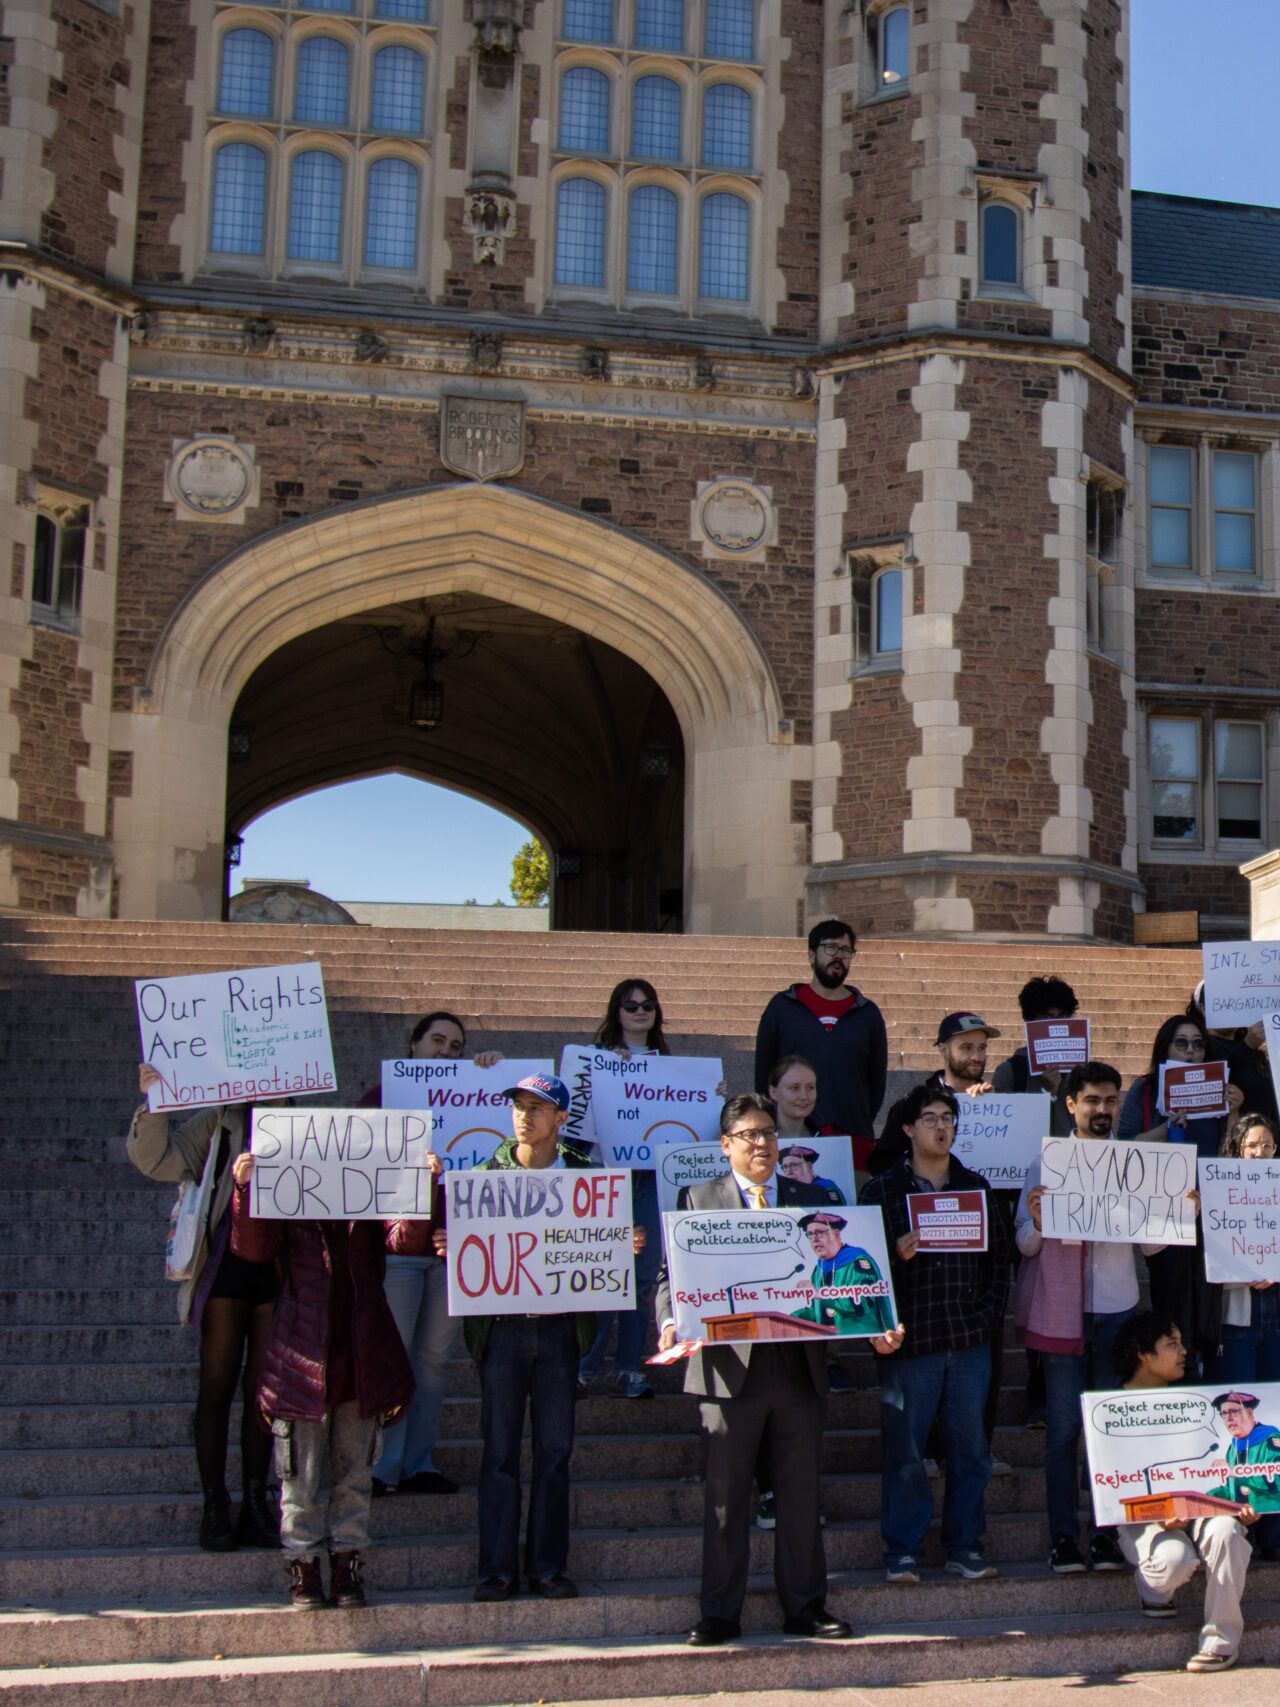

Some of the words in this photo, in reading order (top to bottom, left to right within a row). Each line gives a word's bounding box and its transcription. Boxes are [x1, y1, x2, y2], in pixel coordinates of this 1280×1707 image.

[159, 355, 273, 380] DISCERE
[546, 387, 661, 410] SALVERE
[450, 410, 504, 427] ROBERT
[450, 426, 518, 443] BROOKINGS
[1243, 974, 1263, 985] ARE
[140, 984, 206, 1022] Our
[228, 976, 323, 1022] Rights
[242, 1021, 290, 1032] Academic
[1050, 1027, 1068, 1035] STOP
[149, 1032, 207, 1061] Are
[242, 1034, 290, 1046] Immigrant
[1035, 1040, 1085, 1050] NEGOTIATING
[243, 1047, 276, 1060] LGBTQ
[1037, 1053, 1060, 1062] WITH
[1061, 1052, 1085, 1061] TRUMP
[244, 1059, 269, 1069] Civil
[394, 1061, 458, 1083] Support
[594, 1055, 647, 1077] Support
[159, 1062, 333, 1104] Non-negotiable
[1186, 1072, 1205, 1080] STOP
[625, 1082, 707, 1102] Workers
[1170, 1083, 1223, 1095] NEGOTIATING
[1170, 1096, 1193, 1105] WITH
[1194, 1095, 1222, 1104] TRUMP
[618, 1107, 639, 1120] not
[432, 1116, 444, 1129] ot
[256, 1114, 373, 1161] STAND
[385, 1116, 426, 1163] UP
[1042, 1141, 1108, 1192] SAY
[1105, 1148, 1145, 1193] NO
[1147, 1151, 1188, 1197] TO
[1205, 1164, 1241, 1181] Stand
[1248, 1173, 1260, 1184] up
[1266, 1167, 1280, 1180] for
[256, 1165, 330, 1216] FOR
[343, 1167, 431, 1214] DEI
[453, 1176, 563, 1219] HANDS
[573, 1175, 625, 1218] OFF
[919, 1214, 980, 1223] NEGOTIATING
[1128, 1195, 1196, 1239] DEAL
[1209, 1209, 1246, 1234] Stop
[1254, 1212, 1276, 1230] the
[544, 1227, 630, 1243] HEALTHCARE
[738, 1219, 792, 1234] creeping
[921, 1229, 945, 1238] WITH
[948, 1229, 979, 1237] TRUMP
[457, 1232, 543, 1298] OUR
[545, 1250, 612, 1265] RESEARCH
[546, 1268, 630, 1297] JOBS!
[676, 1290, 727, 1307] Reject
[734, 1287, 759, 1301] the
[764, 1287, 814, 1305] Trump
[820, 1283, 889, 1305] compact!
[1154, 1401, 1206, 1415] creeping
[1095, 1470, 1142, 1489] Reject
[1151, 1468, 1174, 1481] the
[1180, 1467, 1229, 1484] Trump
